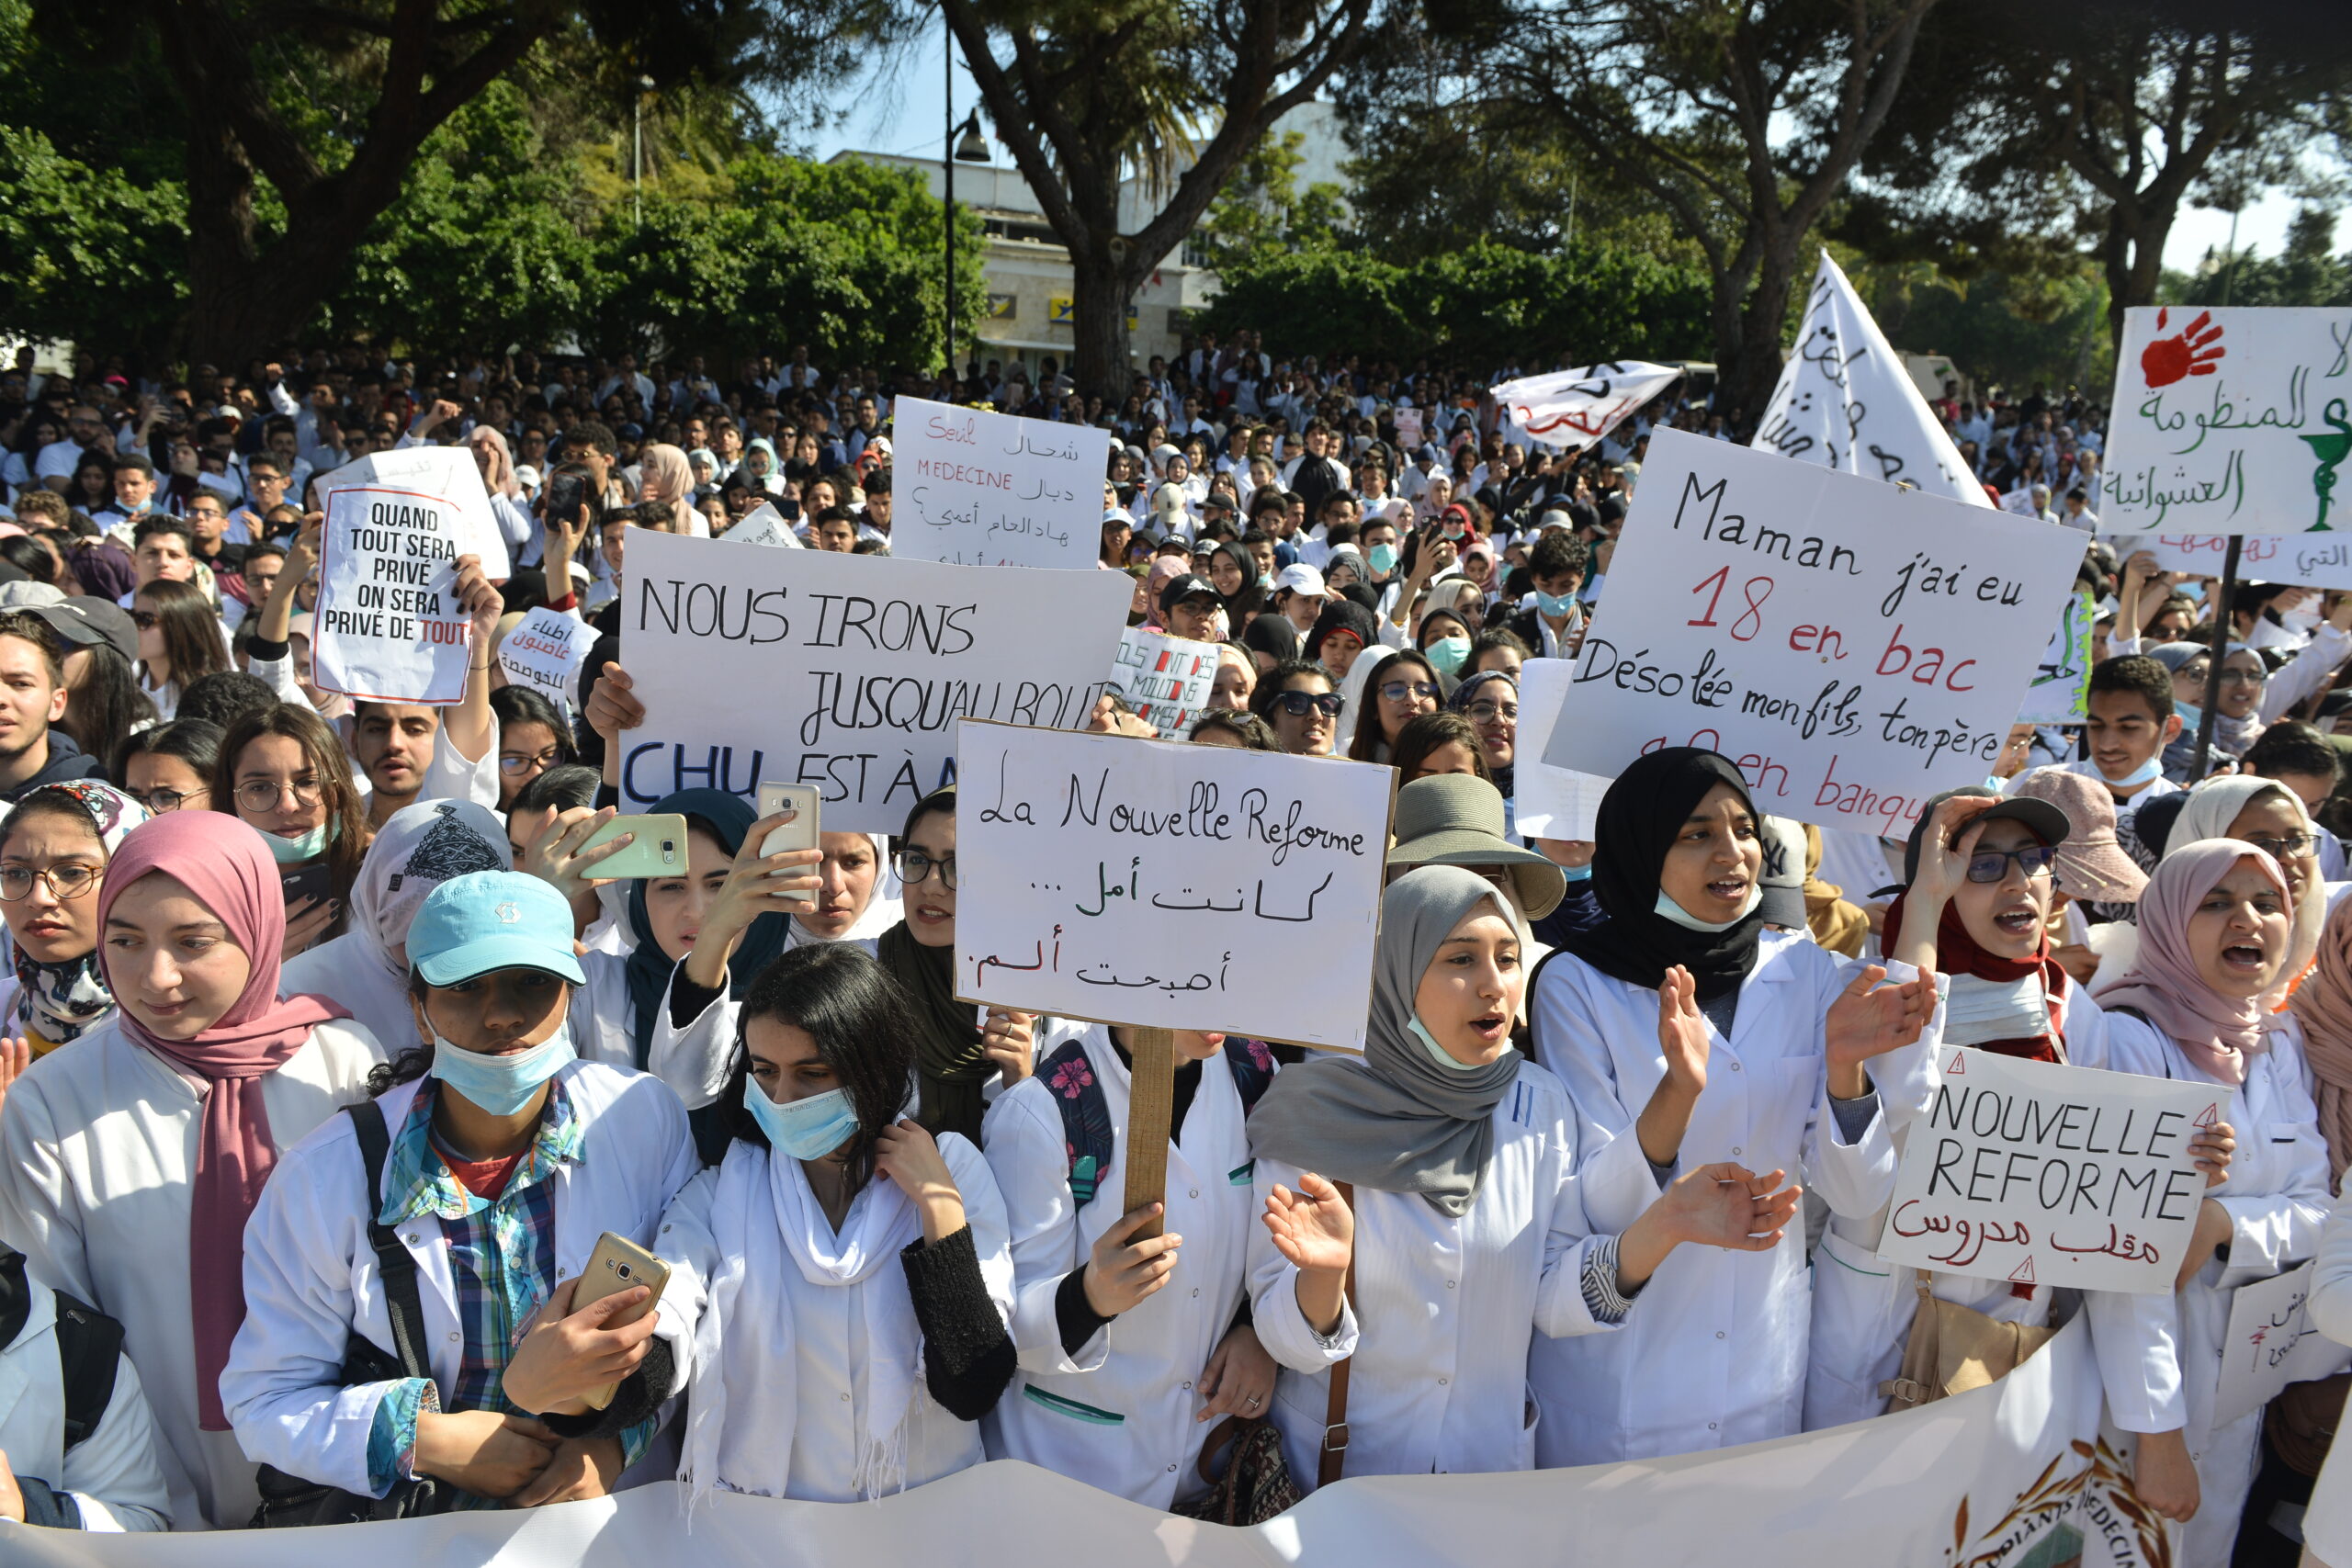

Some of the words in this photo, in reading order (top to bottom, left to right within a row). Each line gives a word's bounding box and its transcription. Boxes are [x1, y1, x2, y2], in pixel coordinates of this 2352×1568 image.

[1003, 434, 1079, 461] شحال
[918, 459, 1012, 490] MEDECINE
[2103, 449, 2245, 530] العشوائية
[371, 502, 438, 532] QUAND
[351, 528, 401, 552] TOUT
[406, 534, 457, 561] SERA
[1673, 471, 1863, 575] Maman
[1881, 551, 1968, 617] j'ai
[1976, 576, 2025, 606] eu
[2297, 544, 2348, 577] التي
[373, 558, 432, 587] PRIVÉ
[357, 584, 384, 609] ON
[390, 589, 440, 616] SERA
[640, 578, 789, 645] NOUS
[803, 593, 976, 656] IRONS
[324, 609, 384, 637] PRIVÉ
[390, 616, 414, 641] DE
[420, 619, 469, 646] TOUT
[512, 631, 571, 660] غاضبون
[531, 620, 576, 642] أطباء
[1686, 564, 1774, 642] 18
[1788, 624, 1849, 660] en
[1875, 623, 1977, 693] bac
[623, 741, 763, 805] CHU
[796, 753, 878, 804] EST
[883, 749, 925, 805] À
[1814, 754, 1929, 838] banqu
[980, 749, 1035, 825] La
[1060, 767, 1232, 840] Nouvelle
[1239, 787, 1365, 866] Reforme
[1076, 855, 1141, 917] أمل
[1151, 871, 1333, 922] كانت
[1076, 950, 1232, 999] أصبحت
[1929, 1083, 2186, 1159] NOUVELLE
[1928, 1138, 2197, 1221] REFORME
[1893, 1199, 2030, 1267] مدروس
[2050, 1223, 2159, 1265] مقلب
